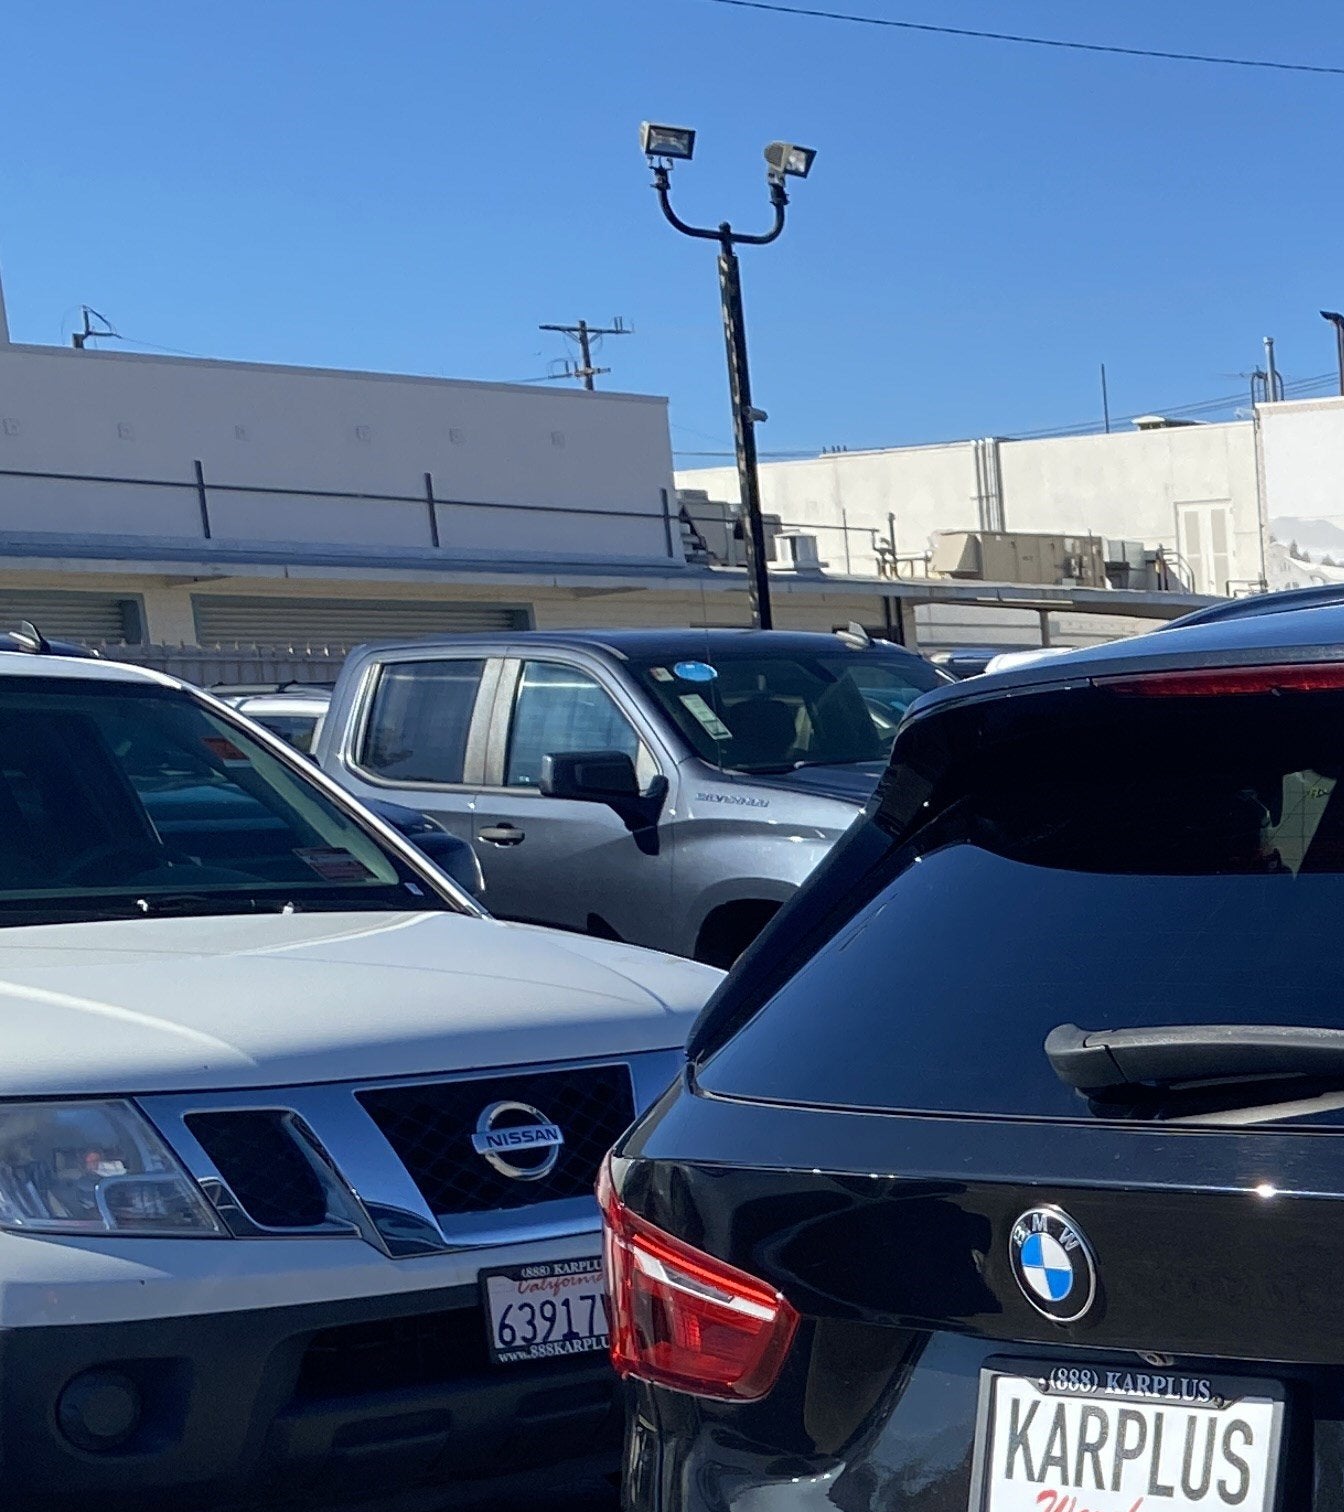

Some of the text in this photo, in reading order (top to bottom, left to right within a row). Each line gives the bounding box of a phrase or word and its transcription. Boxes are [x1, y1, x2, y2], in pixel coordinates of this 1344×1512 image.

[485, 1128, 559, 1148] NISSAN
[1012, 1212, 1082, 1252] BMW
[520, 1259, 602, 1279] (888) KARPLU
[1049, 1367, 1211, 1402] (888) KARPLUS
[1004, 1397, 1254, 1506] KARPLUS
